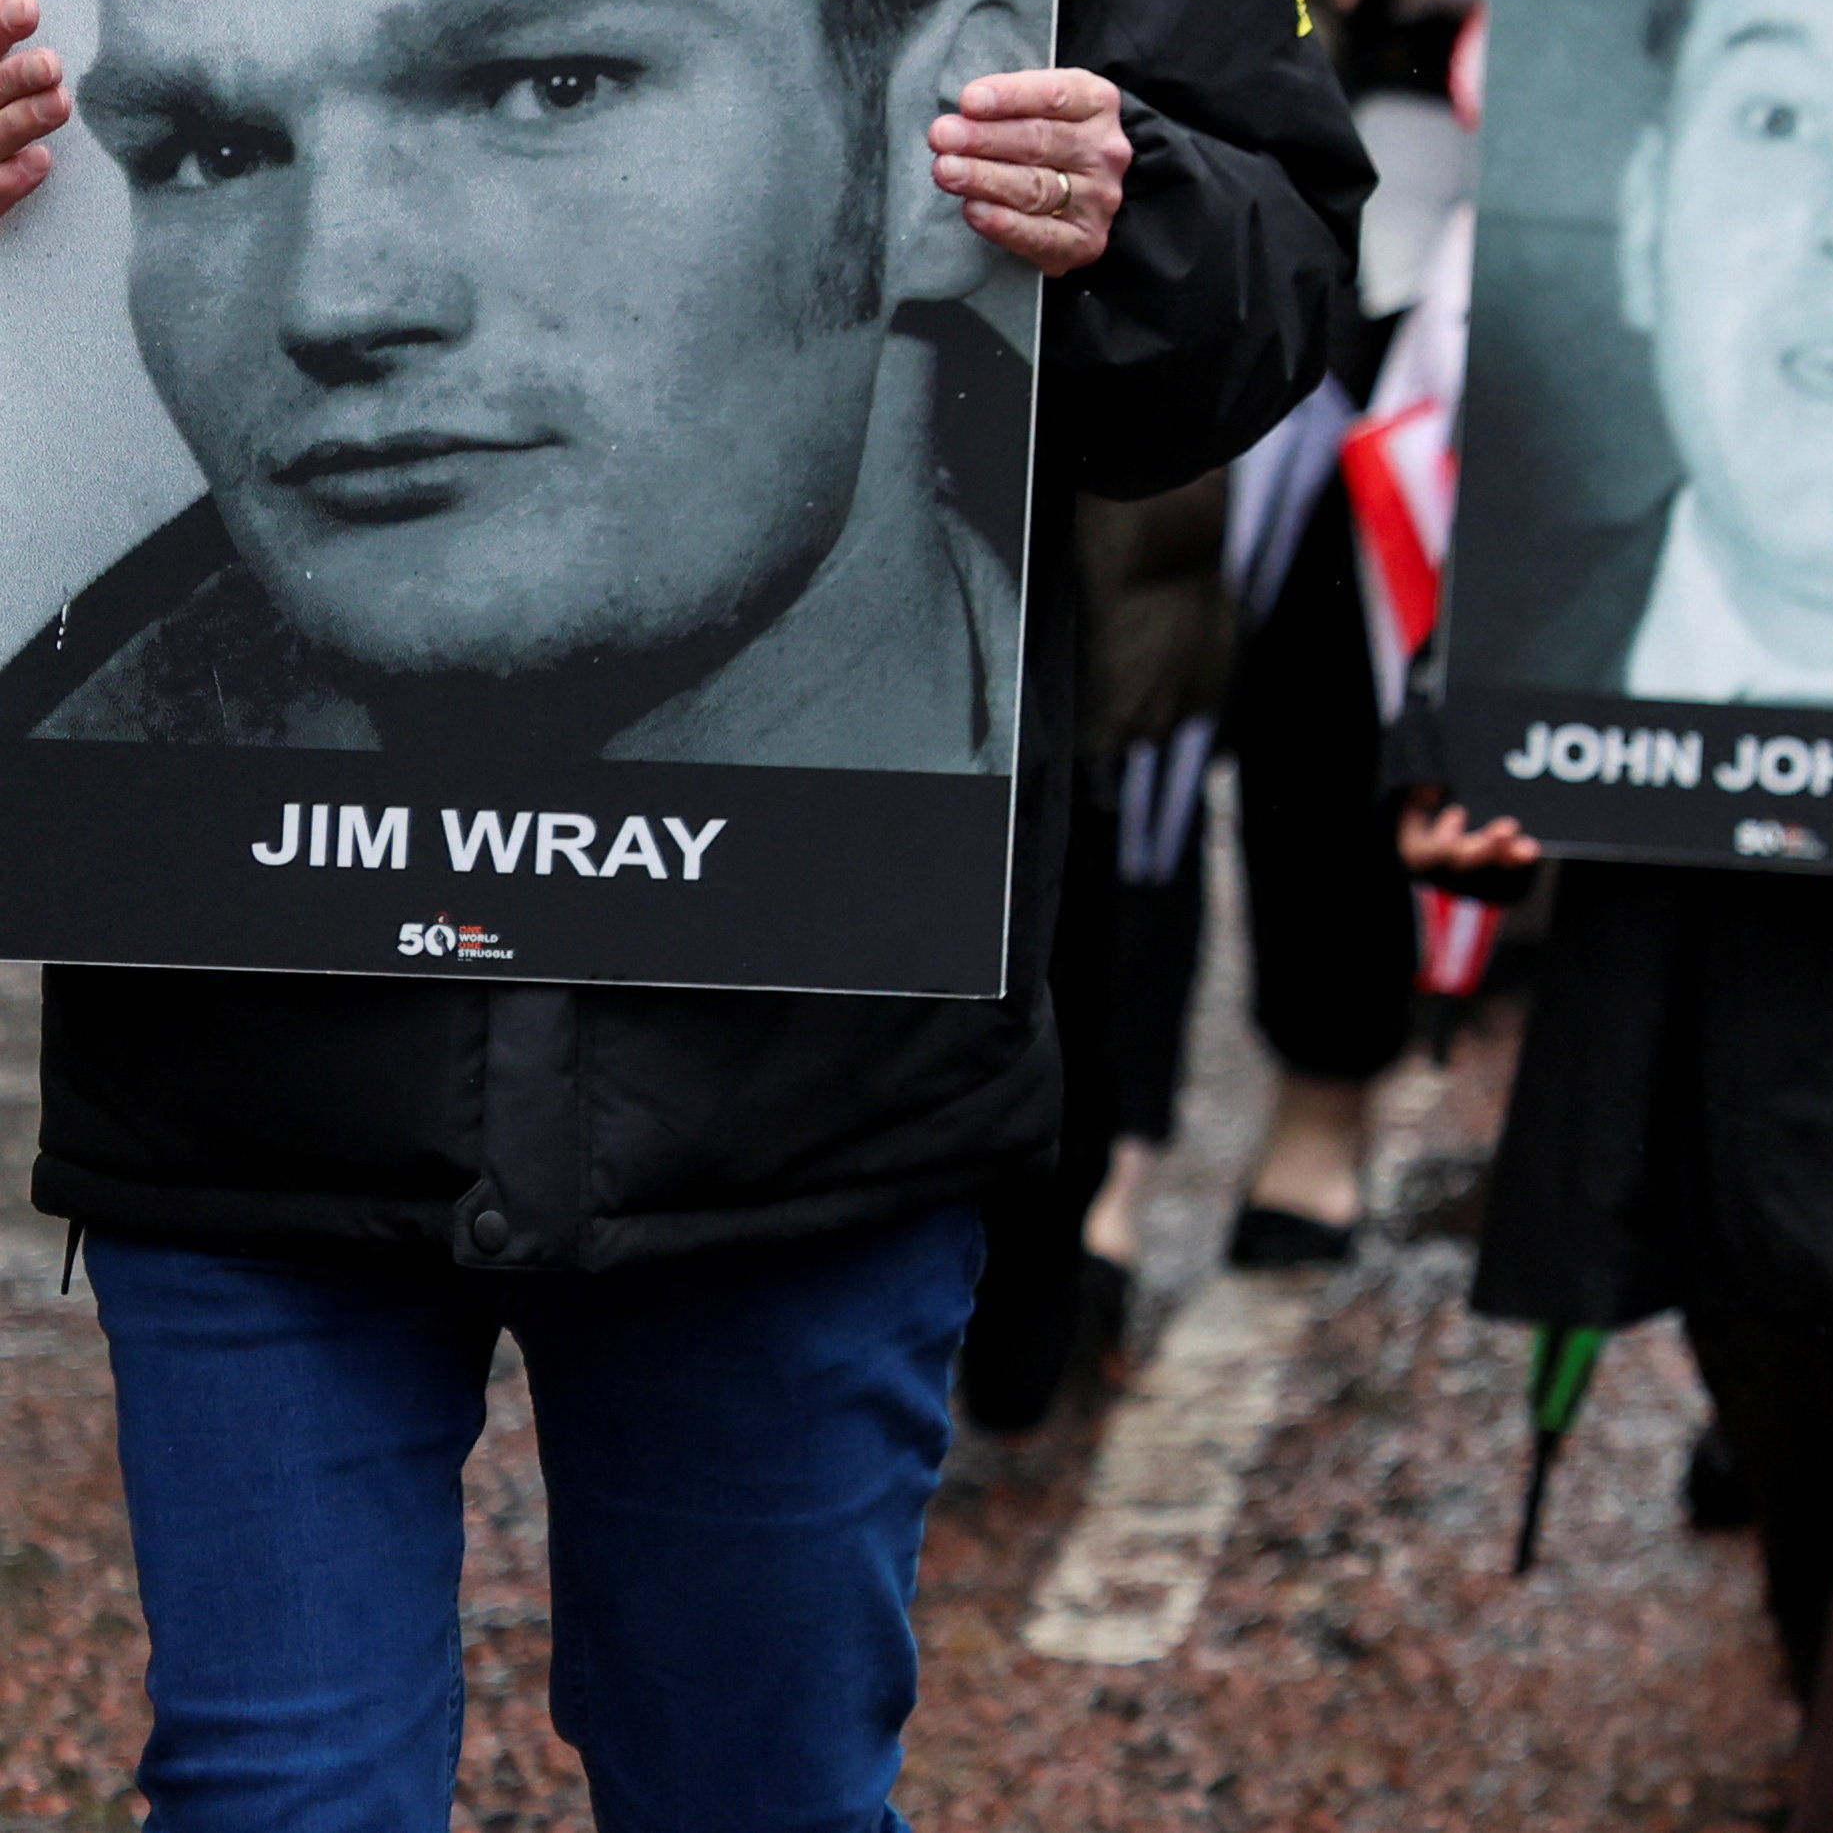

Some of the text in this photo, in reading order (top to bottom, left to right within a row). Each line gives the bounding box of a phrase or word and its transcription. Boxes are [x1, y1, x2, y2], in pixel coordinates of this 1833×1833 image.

[1505, 722, 1703, 789] JOHN
[251, 803, 727, 881] JIM WRAY
[397, 923, 456, 956] 50
[458, 925, 483, 934] ONE
[459, 933, 499, 944] WORLD
[457, 949, 514, 960] STRUGGLE
